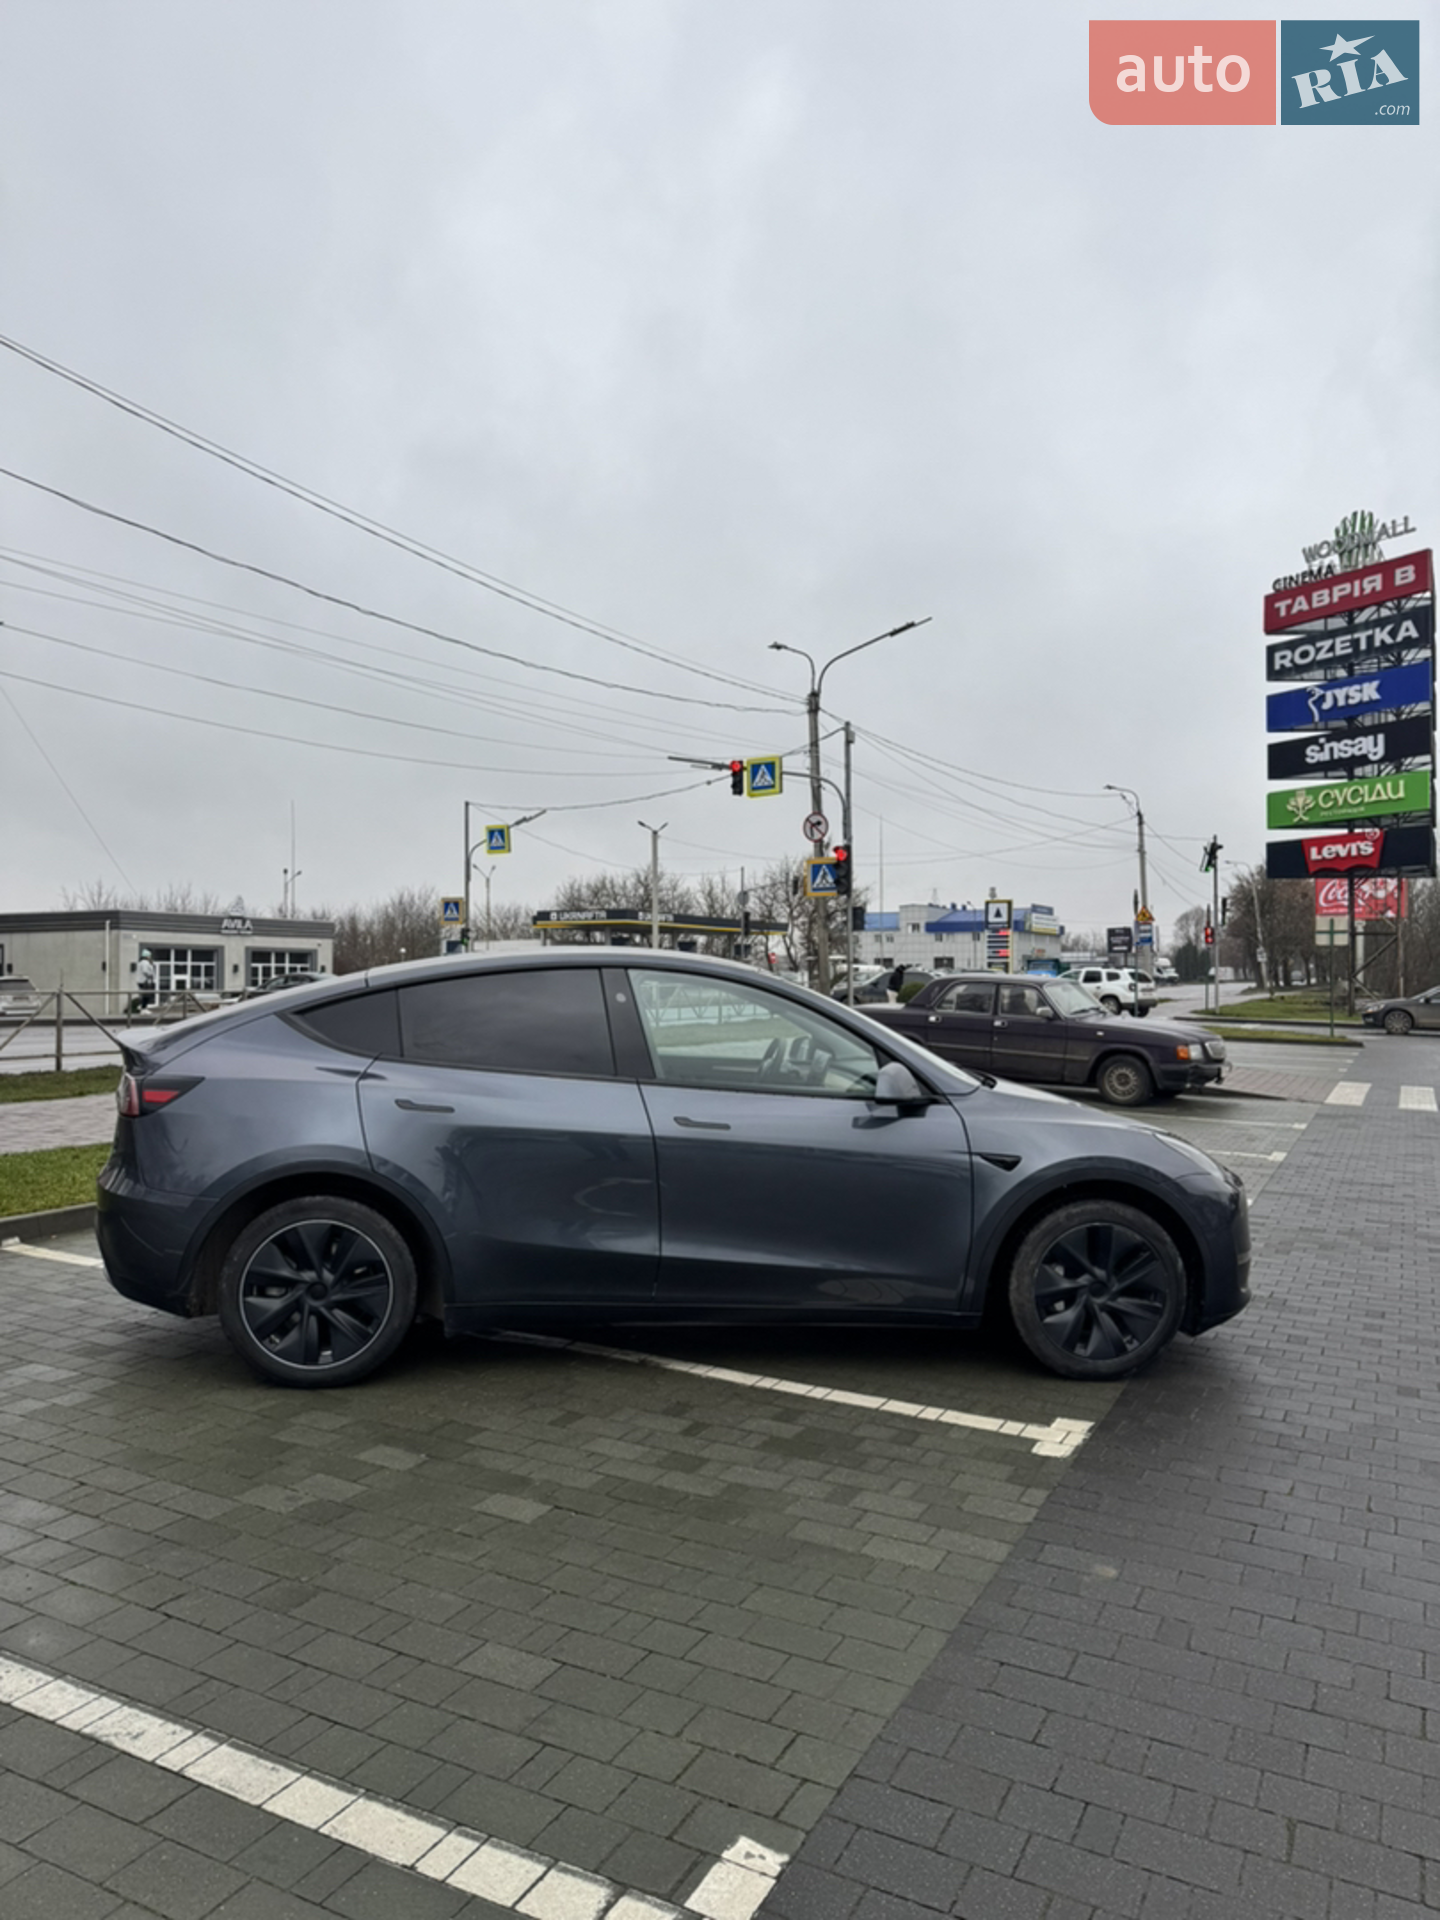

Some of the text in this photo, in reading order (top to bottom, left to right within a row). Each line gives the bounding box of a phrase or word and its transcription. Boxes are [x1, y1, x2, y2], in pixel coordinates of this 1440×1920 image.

[1272, 563, 1336, 592] CINEMA
[1273, 564, 1417, 618] ТАВРІЯ В
[1273, 619, 1420, 671] ROZETKA
[1321, 680, 1382, 711] JYSK
[1305, 733, 1386, 764] sinsay
